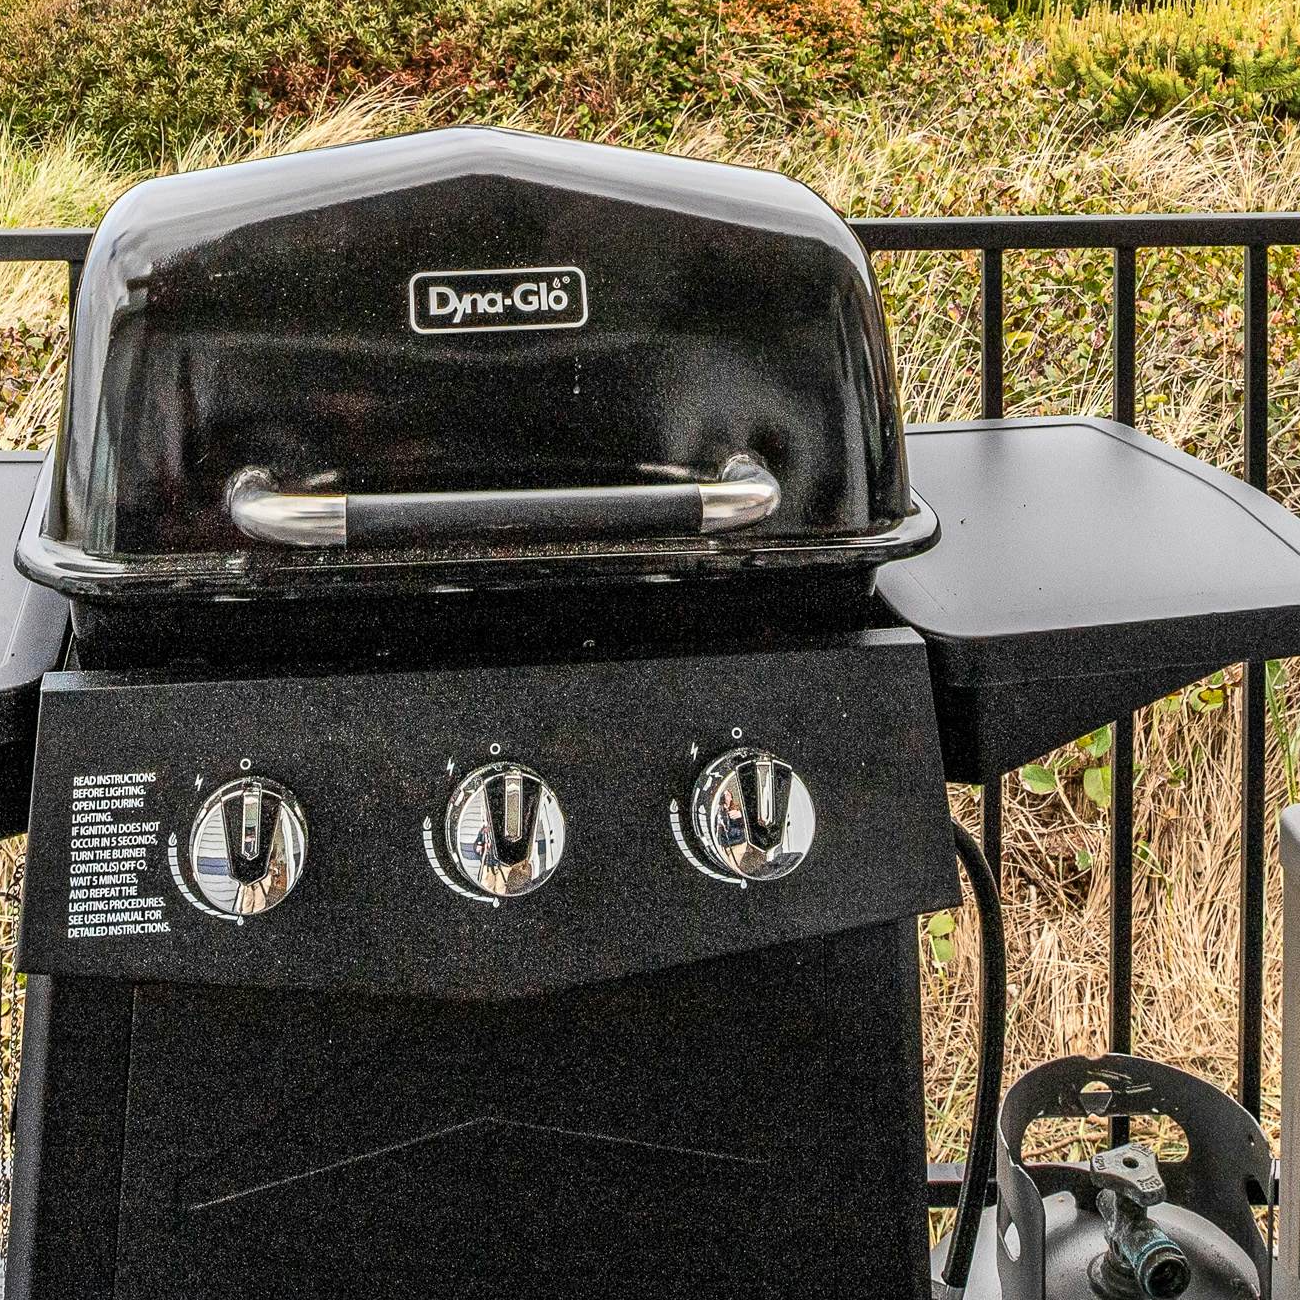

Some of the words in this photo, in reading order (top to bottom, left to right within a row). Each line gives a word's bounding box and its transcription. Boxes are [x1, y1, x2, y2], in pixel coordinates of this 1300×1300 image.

[428, 280, 568, 323] Dyna-Glo
[74, 776, 96, 786] READ
[97, 773, 156, 784] INSTRUCTIONS
[73, 788, 104, 799] BEFORE
[106, 785, 146, 797] LIGHTING.
[72, 801, 96, 811] OPEN
[97, 800, 110, 809] LID
[111, 798, 144, 808] DURING
[72, 812, 113, 823] LIGHTING.
[72, 826, 79, 836] IF
[80, 824, 118, 835] IGNITION
[119, 823, 141, 833] DOES
[142, 821, 160, 831] NOT
[71, 838, 100, 848] OCCUR
[101, 837, 110, 847] IN
[111, 837, 117, 846] 5
[118, 834, 158, 845] SECONDS,
[71, 851, 94, 861] TURN
[95, 850, 111, 860] THE
[112, 848, 146, 858] BURNER
[70, 863, 119, 874] CONTROL(S)
[120, 861, 136, 870] OFF
[70, 876, 91, 887] WAIT
[92, 876, 98, 885] 5
[99, 873, 138, 884] MINUTES,
[69, 889, 88, 900] AND
[90, 887, 120, 898] REPEAT
[121, 886, 137, 896] THE
[69, 901, 108, 912] LIGHTING
[110, 897, 166, 910] PROCEDURES.
[69, 915, 83, 925] SEE
[84, 913, 106, 924] USER
[107, 911, 143, 922] MANUAL
[145, 910, 162, 920] FOR
[68, 926, 107, 938] DETAILED
[109, 922, 171, 935] INSTRUCTIONS.
